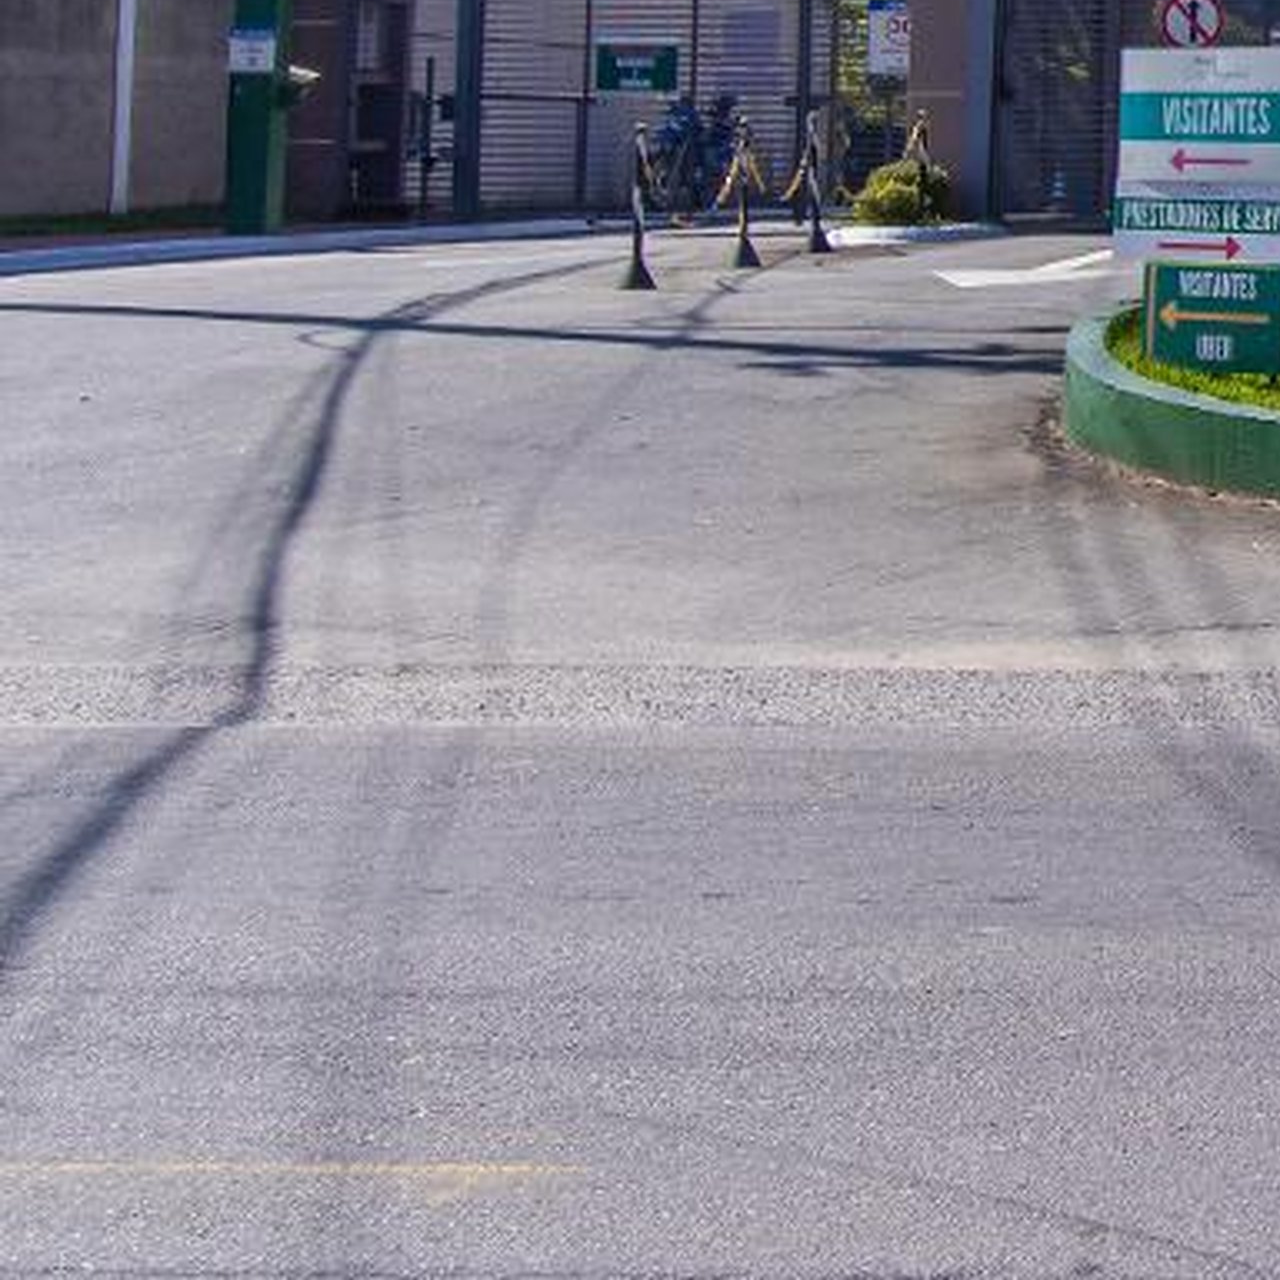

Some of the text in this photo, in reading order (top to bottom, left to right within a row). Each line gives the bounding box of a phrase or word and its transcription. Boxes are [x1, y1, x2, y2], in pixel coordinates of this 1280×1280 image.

[1162, 97, 1272, 135] VISITANTES
[1122, 200, 1220, 228] PRESTADORES
[1223, 203, 1241, 231] DE
[1179, 269, 1258, 300] VISITANTES
[1196, 334, 1233, 361] UBER
